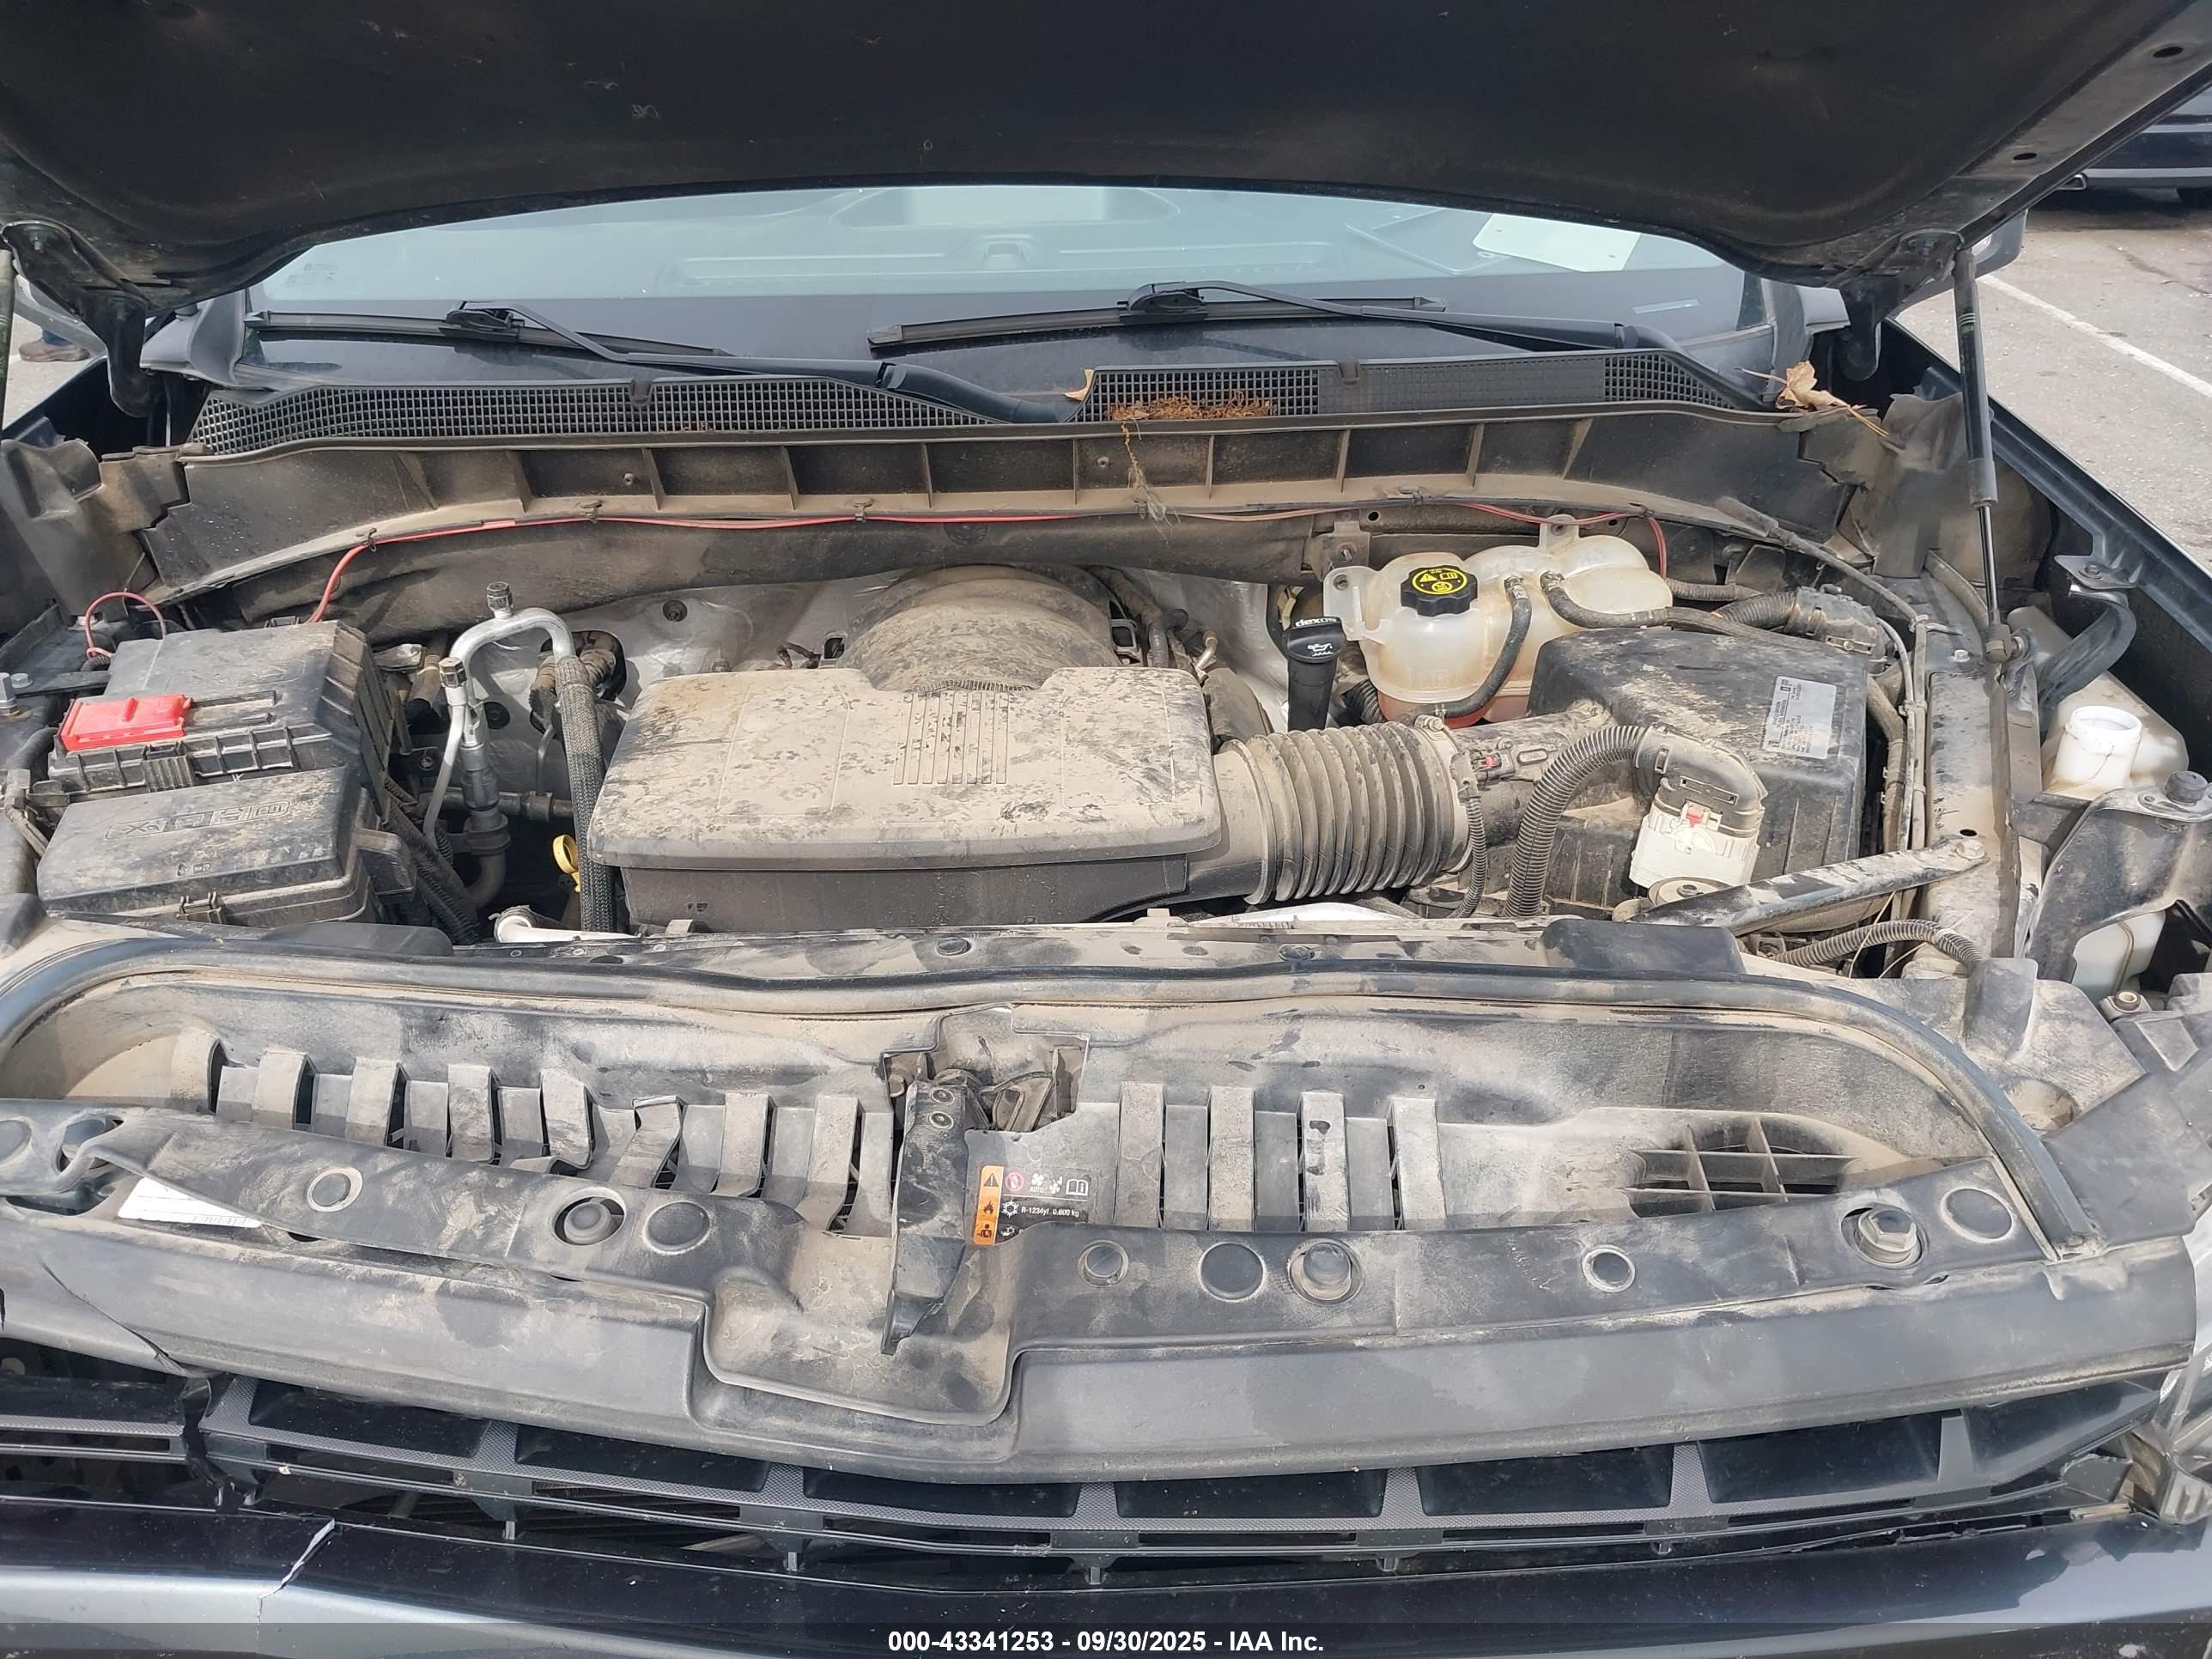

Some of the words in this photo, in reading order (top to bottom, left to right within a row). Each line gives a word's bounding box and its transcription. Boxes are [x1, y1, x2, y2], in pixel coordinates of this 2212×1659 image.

[1295, 617, 1337, 627] dexos
[1021, 1206, 1049, 1216] R-1234yf
[1071, 1209, 1079, 1218] kg
